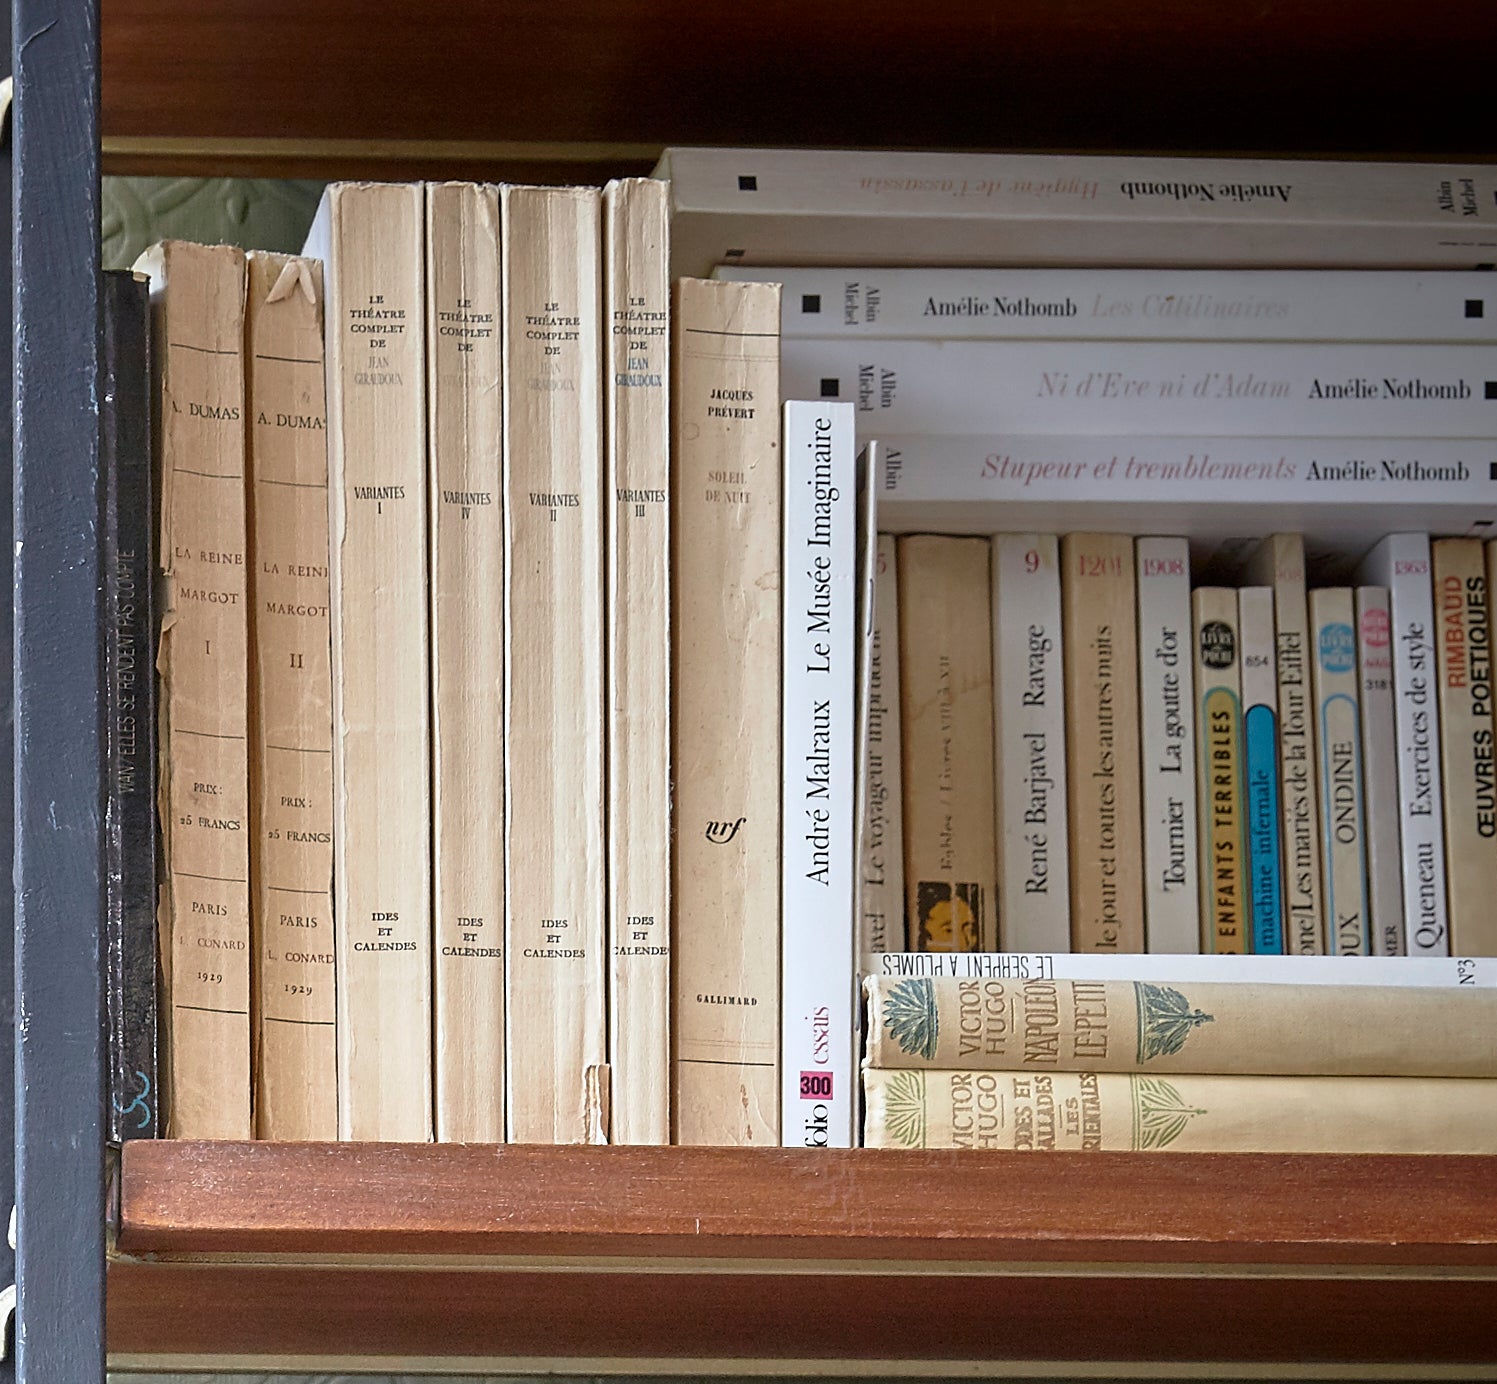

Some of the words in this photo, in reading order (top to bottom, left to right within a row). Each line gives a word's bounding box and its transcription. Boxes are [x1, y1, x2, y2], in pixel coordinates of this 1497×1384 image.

[544, 301, 560, 315] LE
[923, 296, 990, 316] Amélie
[994, 296, 1078, 317] Nothomb
[525, 329, 580, 343] COMPLET
[544, 345, 561, 357] DE
[710, 388, 754, 401] JACQUES
[1308, 378, 1378, 399] Amélie
[1383, 378, 1472, 399] Nothomb
[707, 406, 755, 419] PRÉVERT
[807, 417, 840, 548] Imaginaire
[980, 453, 1087, 486] Stupeur
[1093, 456, 1118, 479] et
[1124, 454, 1297, 480] tremblements
[1306, 460, 1377, 481] Amélie
[1381, 460, 1470, 481] Nothomb
[529, 492, 580, 508] VARIANTES
[549, 508, 557, 522] II
[199, 550, 245, 566] REINE
[180, 587, 239, 605] MARGOT
[806, 556, 831, 634] Musée
[1403, 621, 1434, 672] style
[1444, 576, 1468, 690] RIMBAUD
[1468, 576, 1493, 719] POETIQUES
[806, 642, 831, 674] Le
[1022, 624, 1052, 707] Ravage
[1162, 672, 1186, 739] goutte
[1404, 676, 1427, 706] de
[805, 699, 831, 800] Malraux
[1159, 744, 1182, 774] La
[1408, 709, 1434, 820] Exercices
[1022, 732, 1056, 825] Barjavel
[1211, 711, 1233, 828] TERRIBLES
[1474, 728, 1497, 839] ŒUVRES
[1333, 743, 1356, 844] ONDINE
[705, 817, 747, 845] nrf
[1161, 796, 1186, 892] Tournier
[805, 811, 830, 887] André
[1024, 833, 1051, 895] René
[1215, 839, 1239, 938] ENFANTS
[1414, 841, 1445, 951] Queneau
[191, 901, 228, 917] PARIS
[541, 919, 569, 929] IDES
[523, 948, 586, 959] CALENDES
[546, 934, 562, 944] ET
[197, 971, 224, 984] 1929
[696, 993, 758, 1006] GALLIMARD
[800, 1076, 831, 1096] 300
